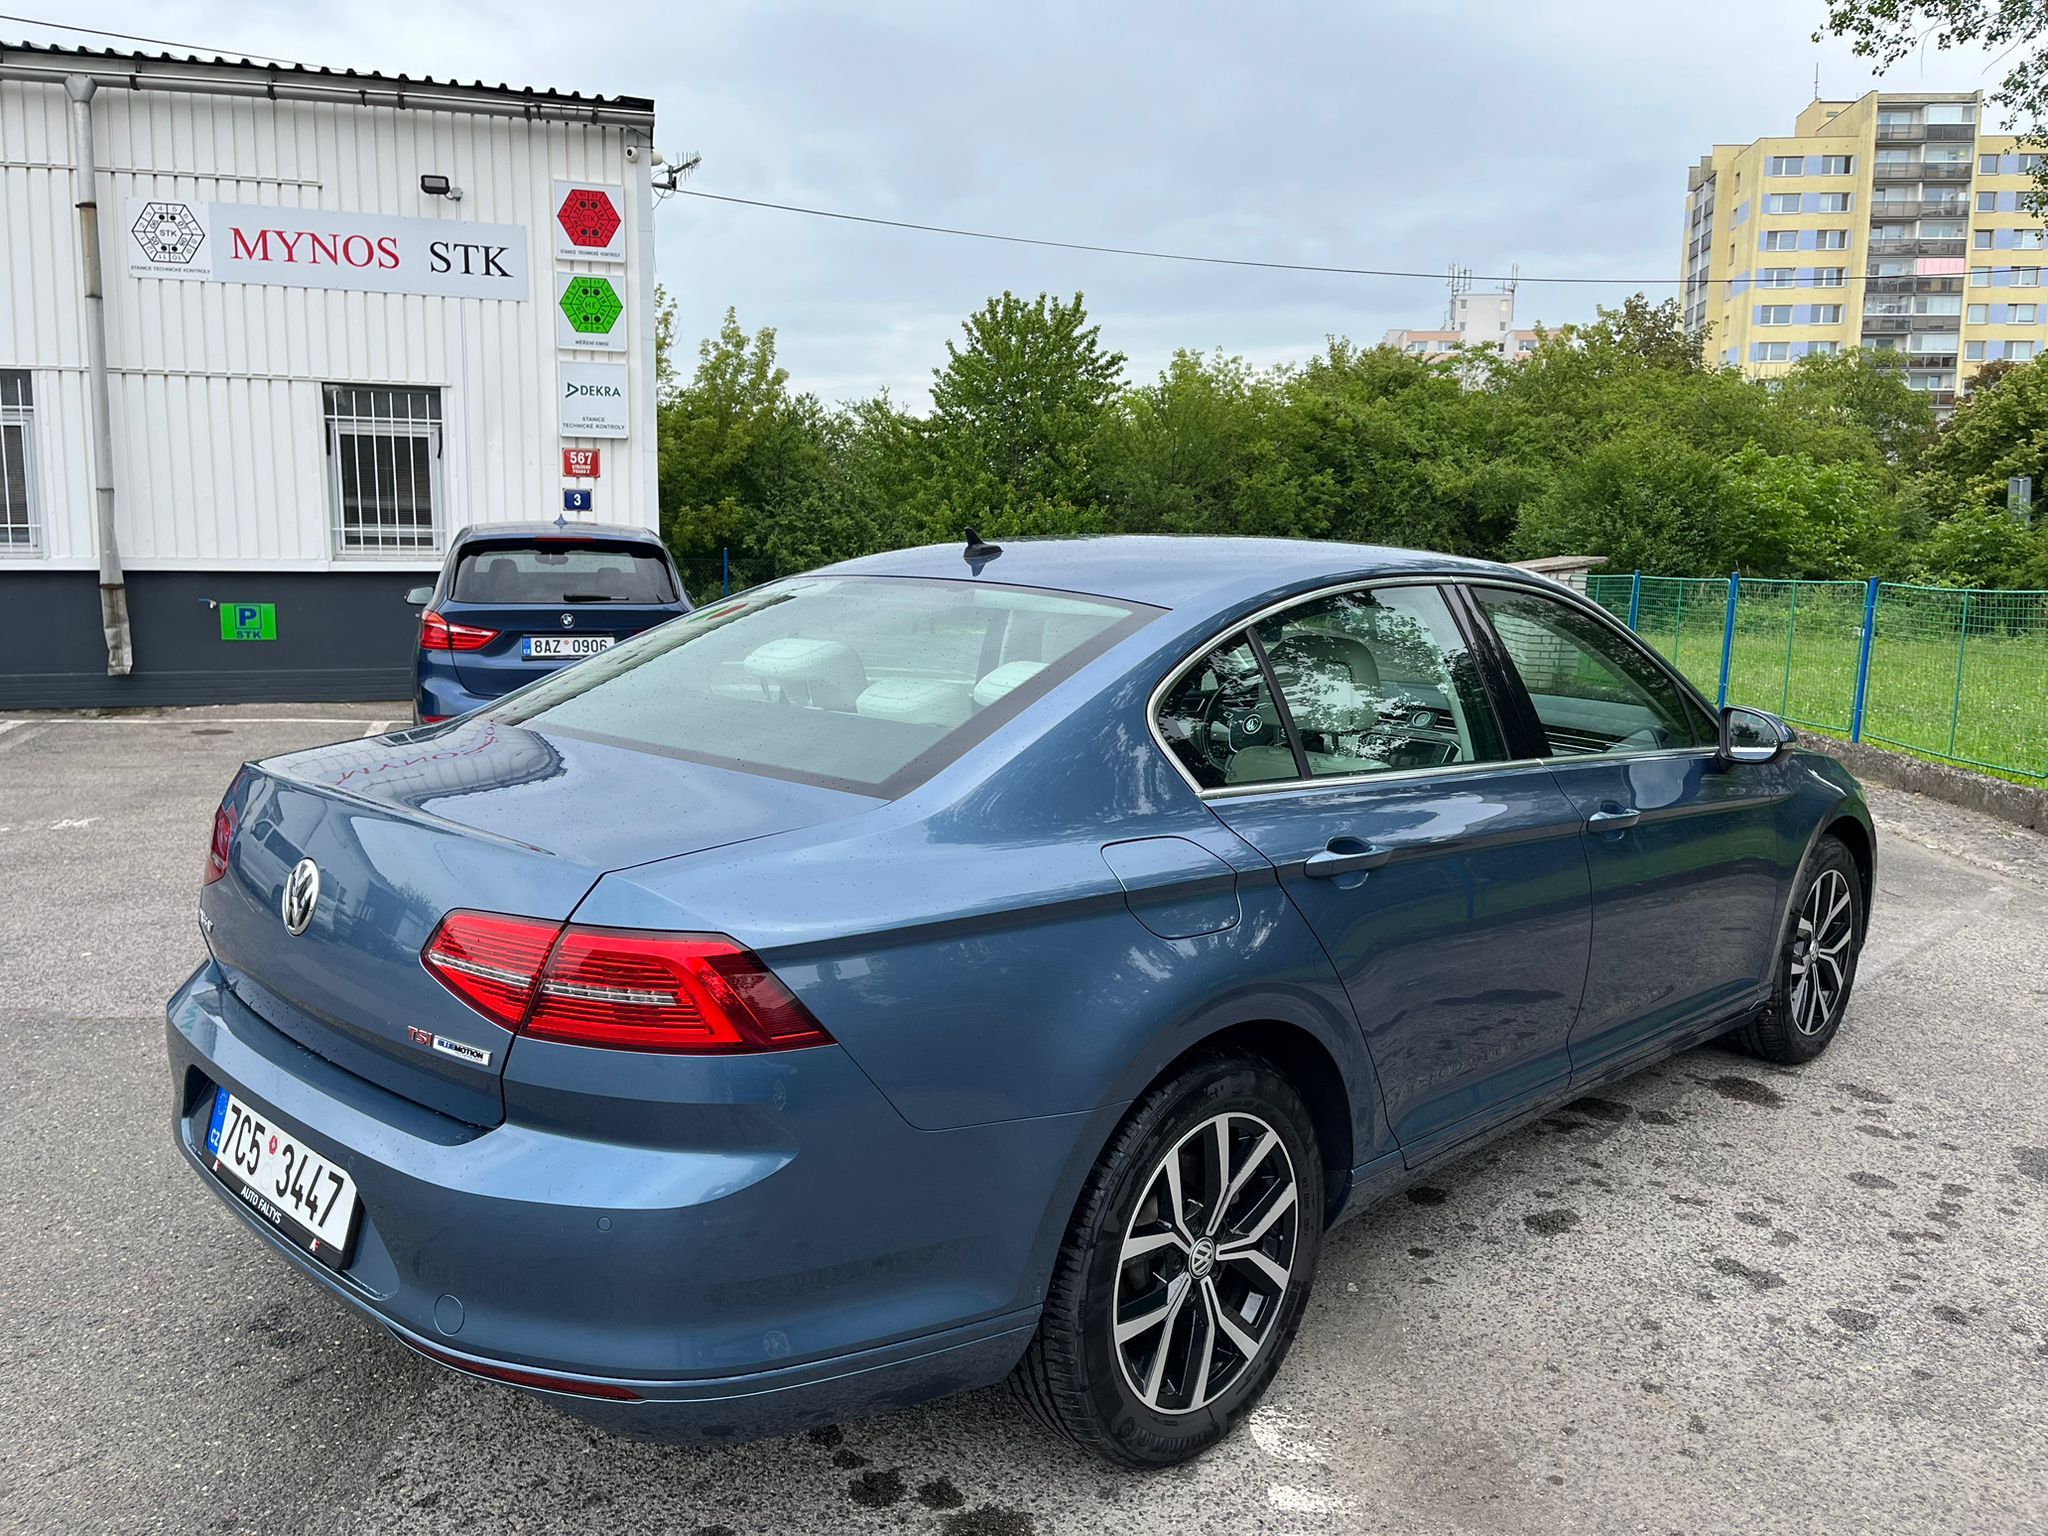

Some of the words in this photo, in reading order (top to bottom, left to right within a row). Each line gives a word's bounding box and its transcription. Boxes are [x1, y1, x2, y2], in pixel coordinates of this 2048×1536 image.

[159, 229, 178, 238] STK
[230, 227, 400, 270] MYNOS
[429, 240, 514, 278] STK
[580, 384, 621, 398] DEKRA
[595, 423, 625, 431] KONTROLY
[569, 451, 593, 465] 567
[573, 493, 582, 506] 3
[239, 607, 257, 627] P
[236, 630, 262, 639] STK
[534, 639, 561, 654] 8AZ
[572, 639, 608, 653] 0906
[209, 1127, 221, 1148] CZ
[222, 1103, 267, 1176] 7C5
[275, 1143, 345, 1229] 3447
[239, 1184, 259, 1205] AUTO
[257, 1198, 283, 1225] FALTYS
